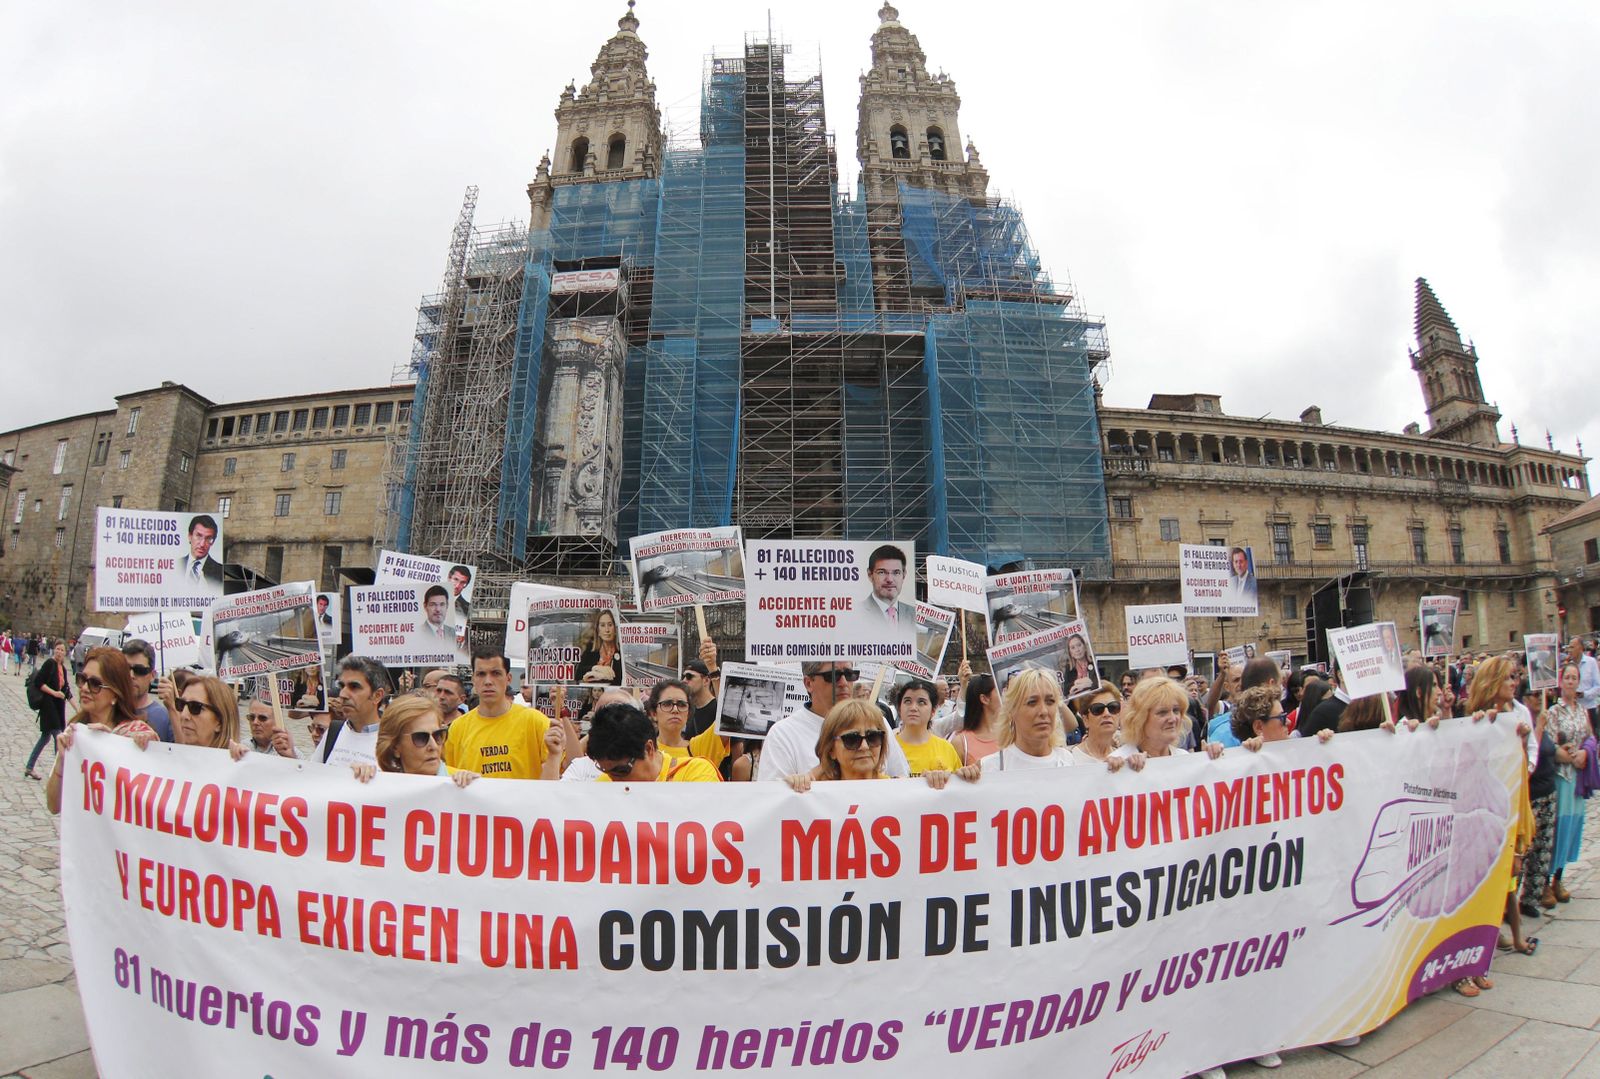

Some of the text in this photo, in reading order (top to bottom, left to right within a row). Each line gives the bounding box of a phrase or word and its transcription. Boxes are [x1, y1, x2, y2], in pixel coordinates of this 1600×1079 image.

[554, 271, 616, 285] PECSA
[106, 516, 177, 531] 81 FALLECIDOS
[116, 532, 134, 544] 140
[137, 533, 180, 546] HERIDOS
[660, 532, 696, 542] QUEREMOS
[688, 540, 737, 550] INDEPENDIENTE
[758, 549, 854, 564] 81 FALLECIDOS
[1192, 550, 1227, 560] FALLECIDOS
[105, 557, 174, 570] ACCIDENTE AVE
[386, 556, 441, 574] 81 FALLECIDOS
[1204, 561, 1230, 570] HERIDOS
[117, 572, 162, 584] SANTIAGO
[392, 568, 405, 578] 140
[408, 570, 441, 583] HERIDOS
[773, 567, 796, 581] 140
[802, 567, 859, 581] HERIDOS
[948, 566, 979, 578] JUSTICIA
[996, 573, 1063, 587] WE WANT TO KNOW
[1186, 578, 1228, 587] ACCIDENTE AVE
[1014, 584, 1052, 594] THE TRUTH
[1194, 589, 1222, 597] SANTIAGO
[100, 596, 123, 607] NIEGAN
[126, 595, 158, 607] COMISIÓN
[161, 597, 169, 607] DE
[235, 589, 285, 606] QUEREMOS UNA
[357, 590, 415, 602] 81 FALLECIDOS
[654, 594, 694, 606] FALLECIDOS
[716, 590, 744, 600] HERIDOS
[262, 595, 310, 612] INDEPENDIENTE
[366, 603, 380, 614] 140
[383, 602, 418, 613] HERIDOS
[530, 600, 553, 612] MENTIRAS
[559, 599, 614, 609] OCULTACIONES
[759, 597, 852, 610] ACCIDENTE AVE
[775, 615, 836, 628] SANTIAGO
[1133, 613, 1178, 624] LA JUSTICIA
[138, 619, 186, 634] LA JUSTICIA
[359, 623, 414, 634] ACCIDENTE AVE
[644, 627, 667, 635] SABER
[368, 636, 405, 645] SANTIAGO
[992, 642, 1027, 659] MENTIRAS
[1034, 623, 1082, 646] OCULTACIONES
[1130, 633, 1184, 646] DESCARRILA
[1346, 630, 1379, 644] FALLECIDOS
[530, 648, 580, 662] ANA PASTOR
[751, 642, 912, 656] NIEGAN COMISIÓN DE INVESTIGACIÓN
[220, 669, 227, 677] 81
[229, 662, 268, 675] FALLECIDOS
[290, 652, 318, 664] HERIDOS
[404, 655, 411, 663] DE
[480, 745, 508, 757] VERDAD
[481, 762, 512, 774] JUSTICIA
[81, 759, 1344, 888] 16 MILLONES DE CIUDADANOS, MÁS DE 100 AYUNTAMIENTOS
[115, 850, 128, 901] Y
[139, 858, 282, 939] EUROPA
[298, 890, 459, 964] EXIGEN
[480, 910, 578, 970] UNA
[599, 891, 901, 971] COMISIÓN
[924, 893, 990, 957] DE
[1010, 832, 1304, 947] INVESTIGACIÓN
[1421, 946, 1484, 983] 24-7-2013
[114, 948, 141, 995] 81
[150, 967, 321, 1046] muertos
[337, 1010, 367, 1056] y
[384, 1013, 490, 1065] más
[508, 1022, 572, 1070] de
[591, 1026, 679, 1071] 140
[696, 1019, 903, 1070] heridos
[1116, 968, 1142, 1012] Y
[1106, 1029, 1170, 1079] Talgo
